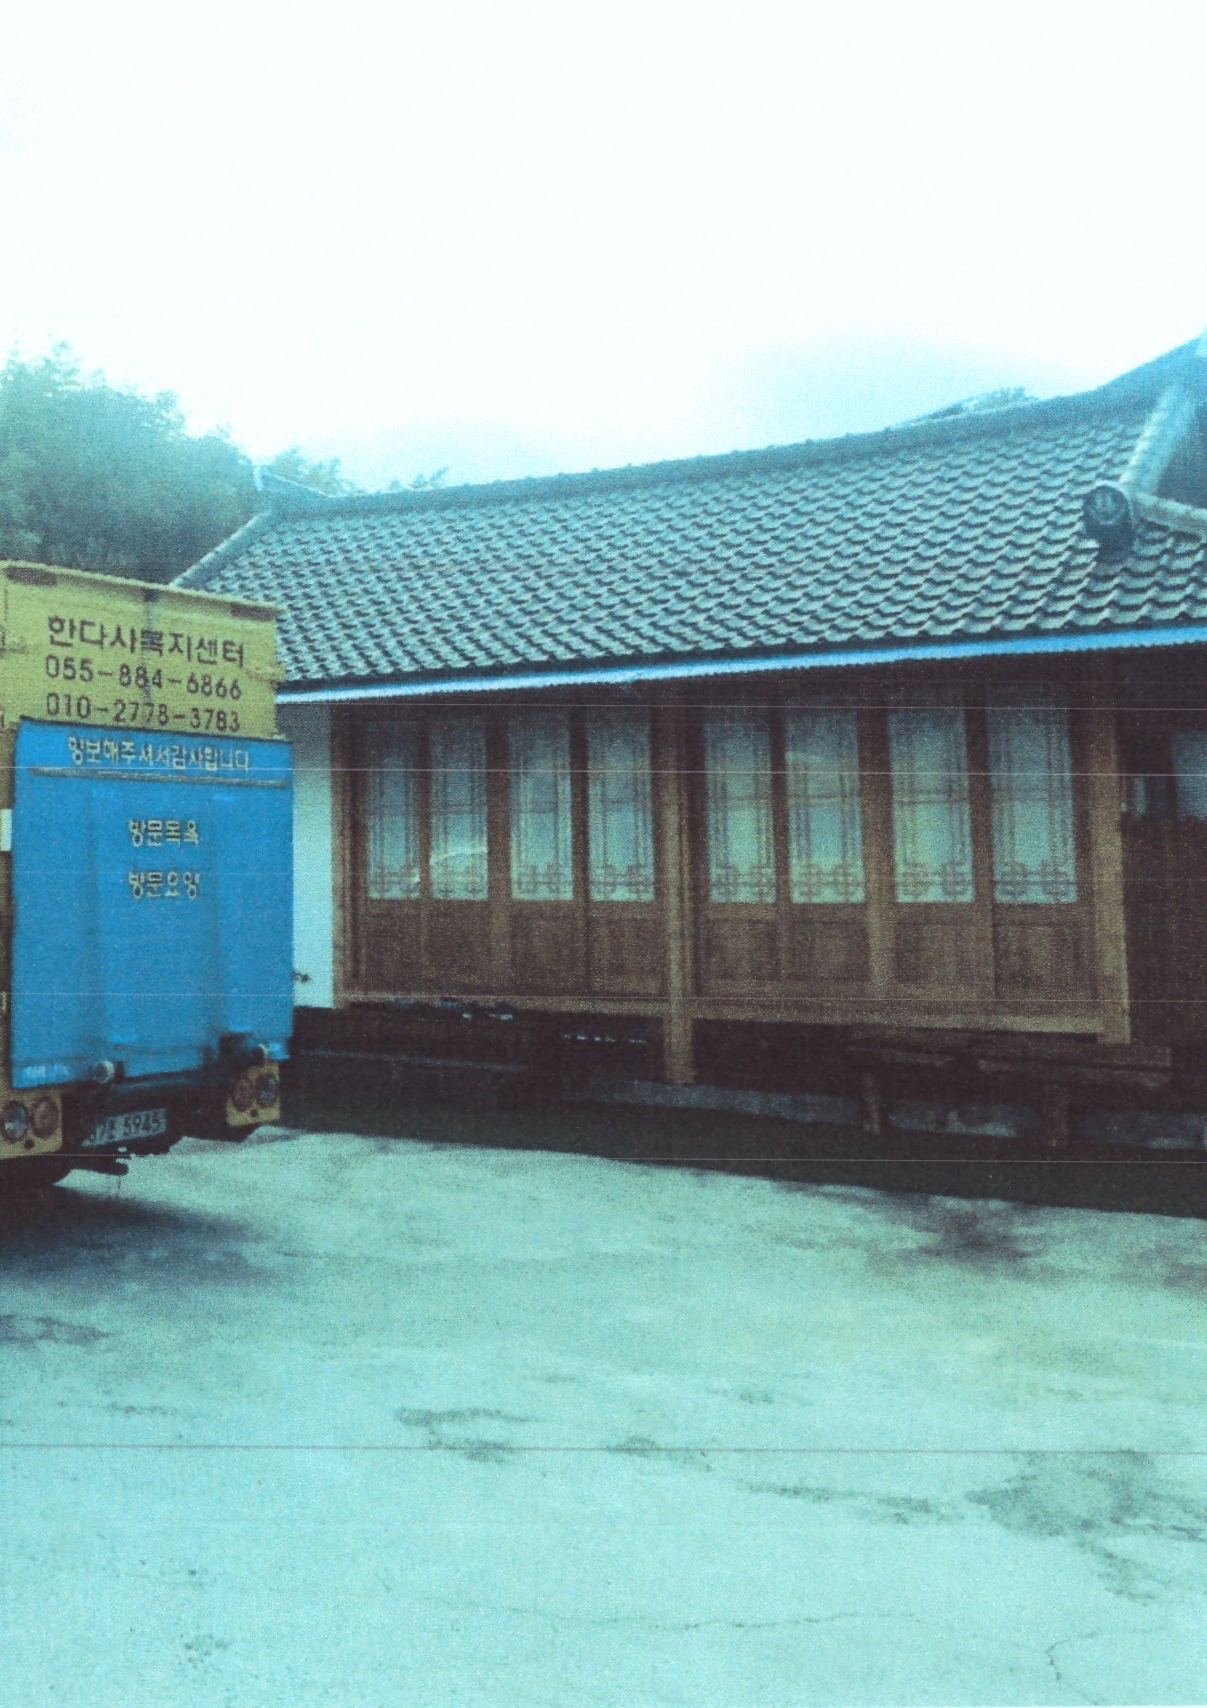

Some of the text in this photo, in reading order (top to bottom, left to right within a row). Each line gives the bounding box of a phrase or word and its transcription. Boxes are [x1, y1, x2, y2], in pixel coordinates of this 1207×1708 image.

[47, 615, 245, 670] 한다사복지센터
[46, 654, 243, 701] 055-884-6866
[46, 692, 241, 733] 010-2778-3783
[128, 819, 199, 848] 방문목욕
[128, 871, 201, 900] 방문요양
